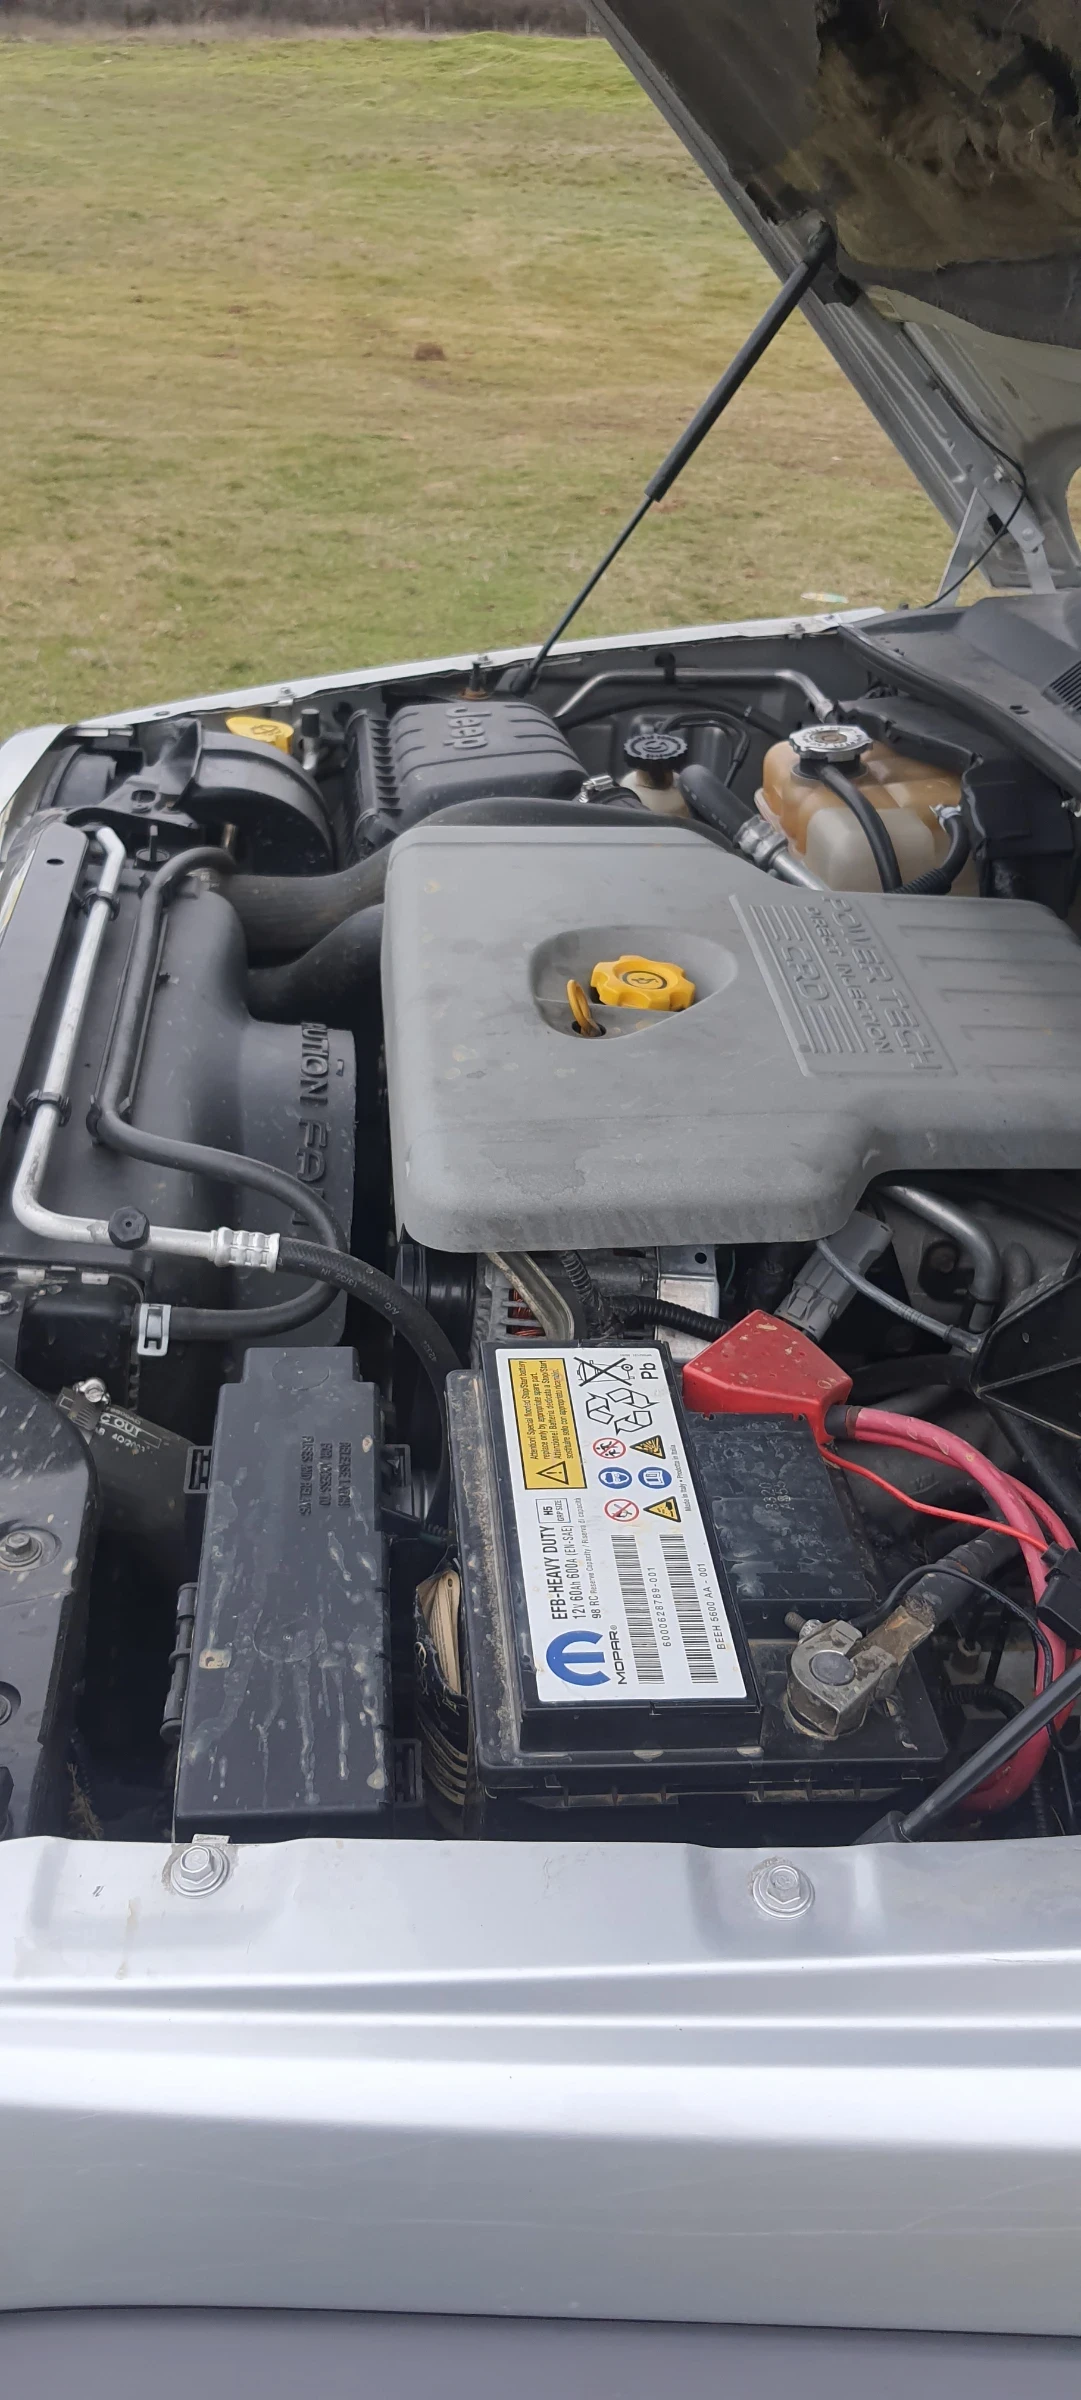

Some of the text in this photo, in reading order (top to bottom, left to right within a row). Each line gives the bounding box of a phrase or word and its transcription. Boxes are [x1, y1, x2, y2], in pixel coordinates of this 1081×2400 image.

[443, 706, 492, 750] Jeep
[781, 946, 830, 1001] CRD
[804, 906, 894, 1054] DIRECT INJECTION
[822, 896, 943, 1070] POWER TECH
[300, 1022, 329, 1105] AUTION
[639, 1362, 659, 1380] Pb
[114, 1418, 141, 1437] OUT
[543, 1505, 553, 1516] H5
[562, 1525, 577, 1556] (EN-SAE)
[581, 1524, 589, 1544] Riserva
[567, 1556, 580, 1579] 600A
[585, 1548, 594, 1572] Capacity
[697, 1563, 708, 1577] 001
[539, 1525, 568, 1620] EFB-HEAVY DUTY
[589, 1572, 597, 1596] Reserve
[570, 1580, 584, 1601] 60Ah
[589, 1595, 600, 1608] RC
[702, 1586, 714, 1599] AA
[593, 1608, 601, 1619] 98
[647, 1567, 672, 1647] 6000628789-001
[707, 1601, 719, 1622] 5600
[712, 1625, 726, 1650] BEEH
